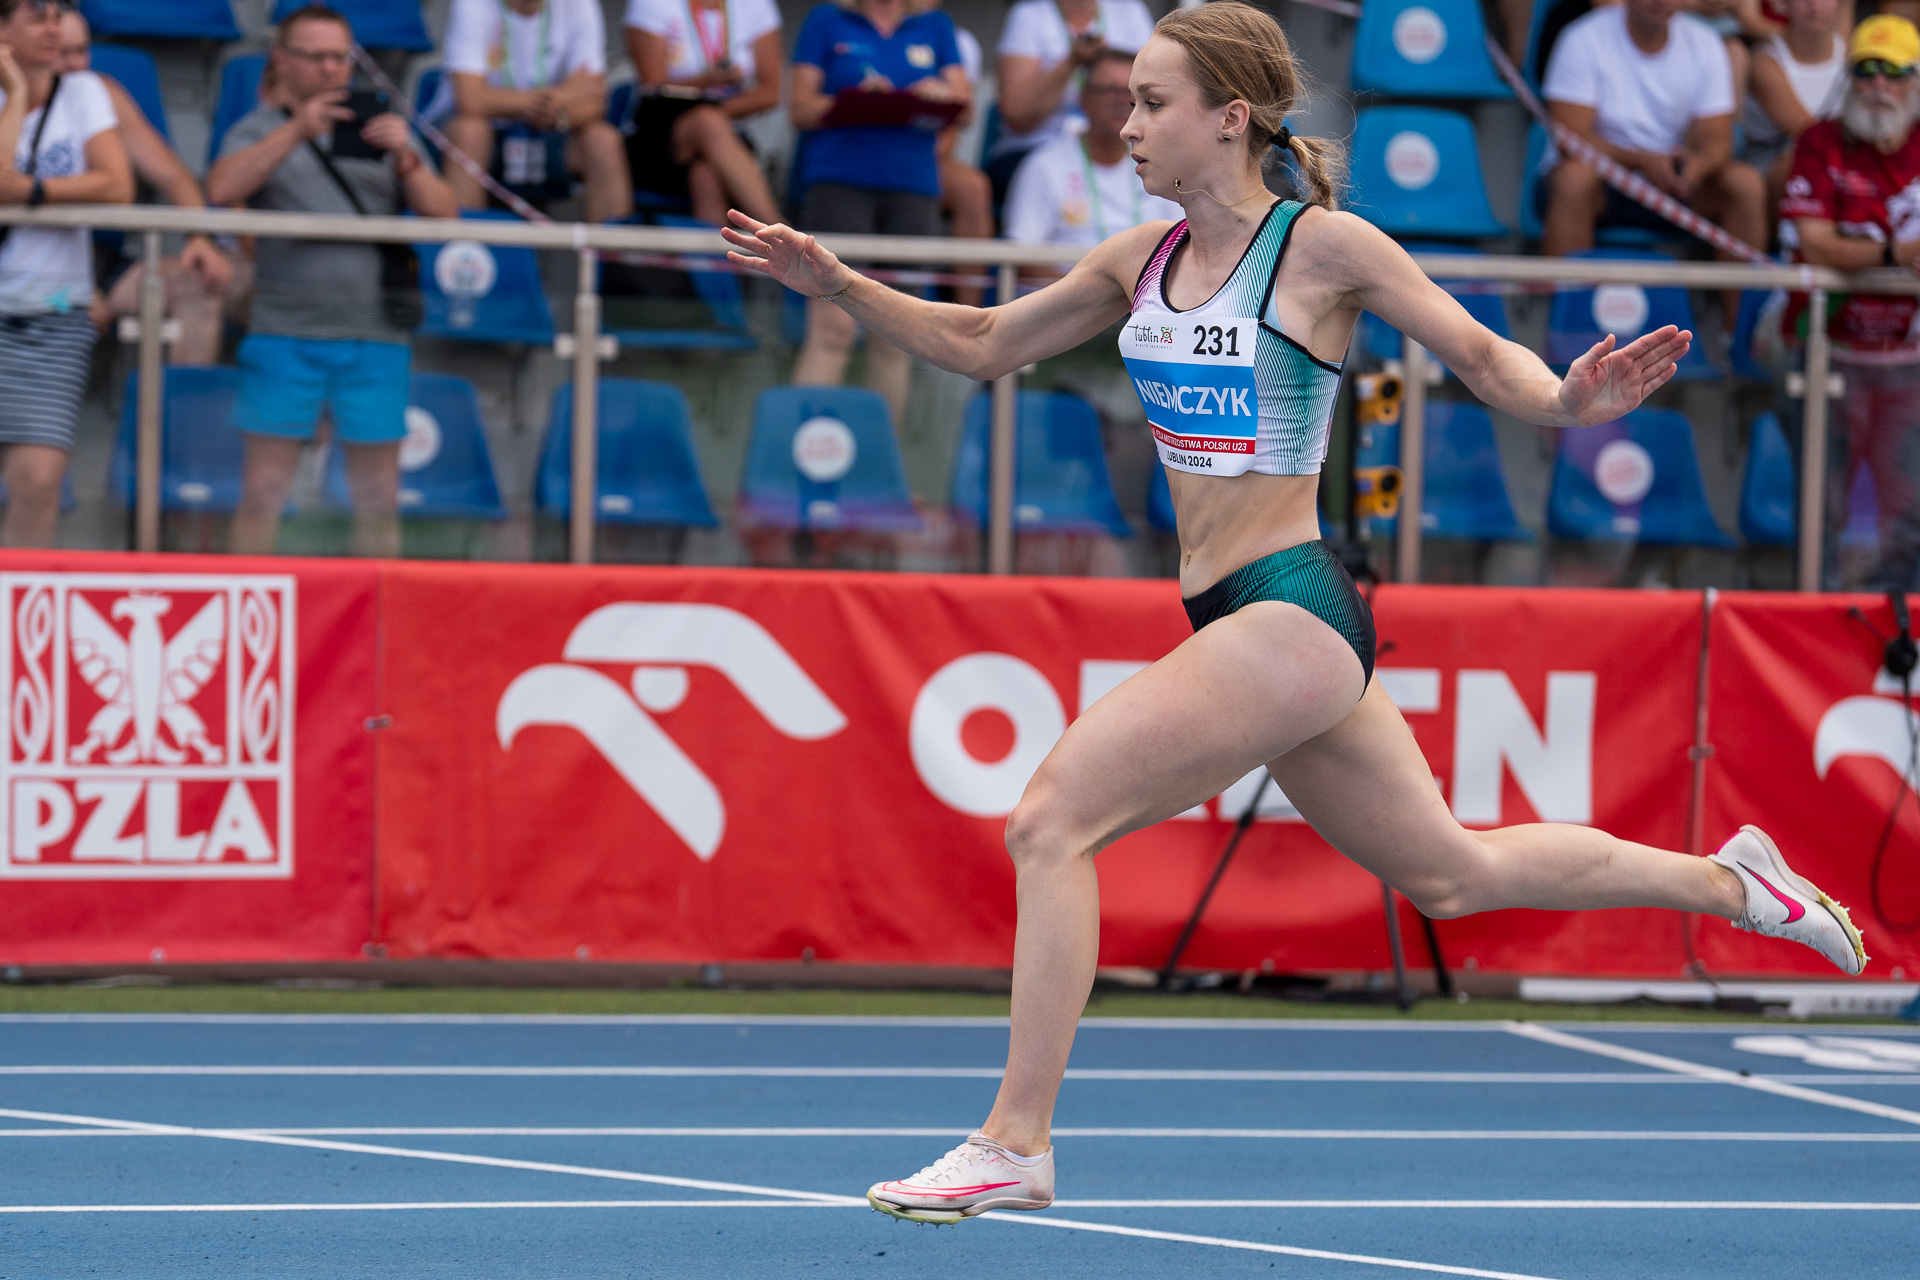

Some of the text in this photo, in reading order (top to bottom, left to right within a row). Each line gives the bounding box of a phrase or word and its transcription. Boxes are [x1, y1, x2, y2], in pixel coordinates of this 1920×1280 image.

[1193, 325, 1240, 356] 231
[1135, 378, 1252, 416] NIEMCZYK
[1203, 440, 1231, 451] POLSKI
[1232, 442, 1248, 452] U23
[1188, 456, 1213, 468] 2024
[13, 779, 277, 862] PZLA
